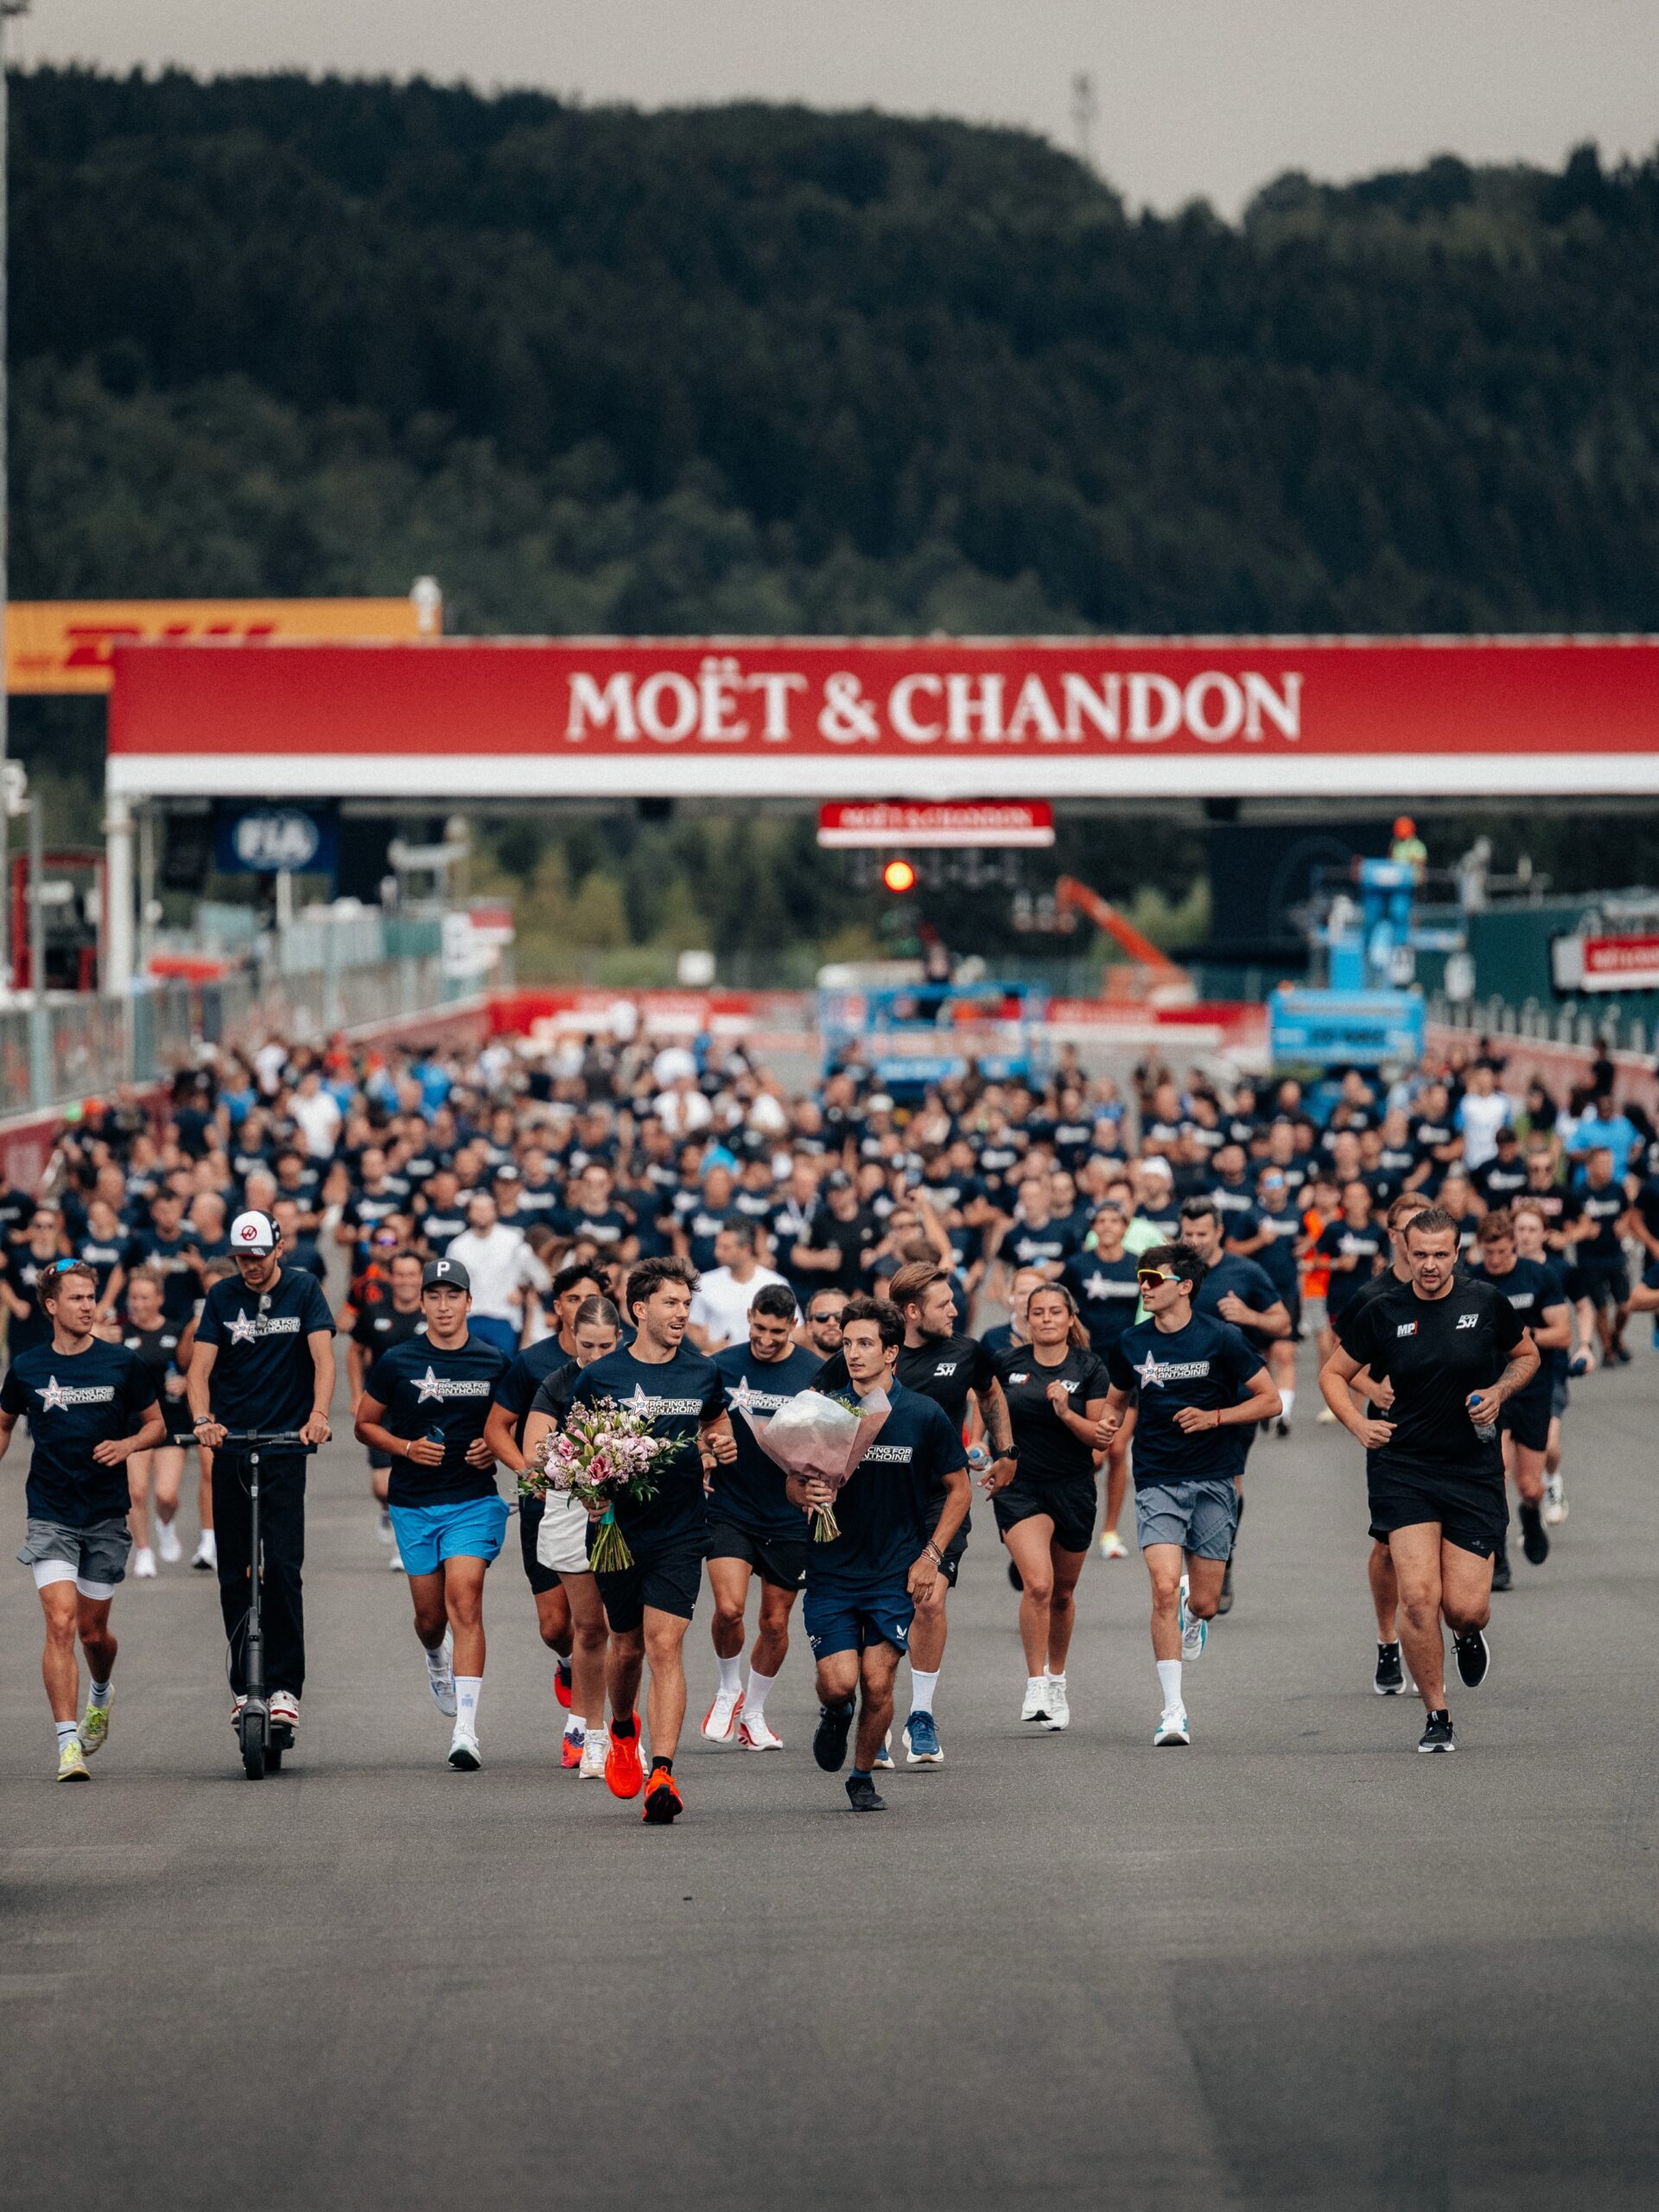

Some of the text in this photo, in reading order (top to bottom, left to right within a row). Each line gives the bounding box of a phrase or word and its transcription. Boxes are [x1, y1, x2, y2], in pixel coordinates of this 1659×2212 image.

[566, 657, 1304, 744] MOËT & CHANDON
[237, 817, 312, 860] FIA
[436, 1261, 450, 1277] P
[1158, 1369, 1207, 1378] ANTHOINE
[62, 1394, 113, 1402] ANTHOINE
[864, 1452, 911, 1461] NTHOINE
